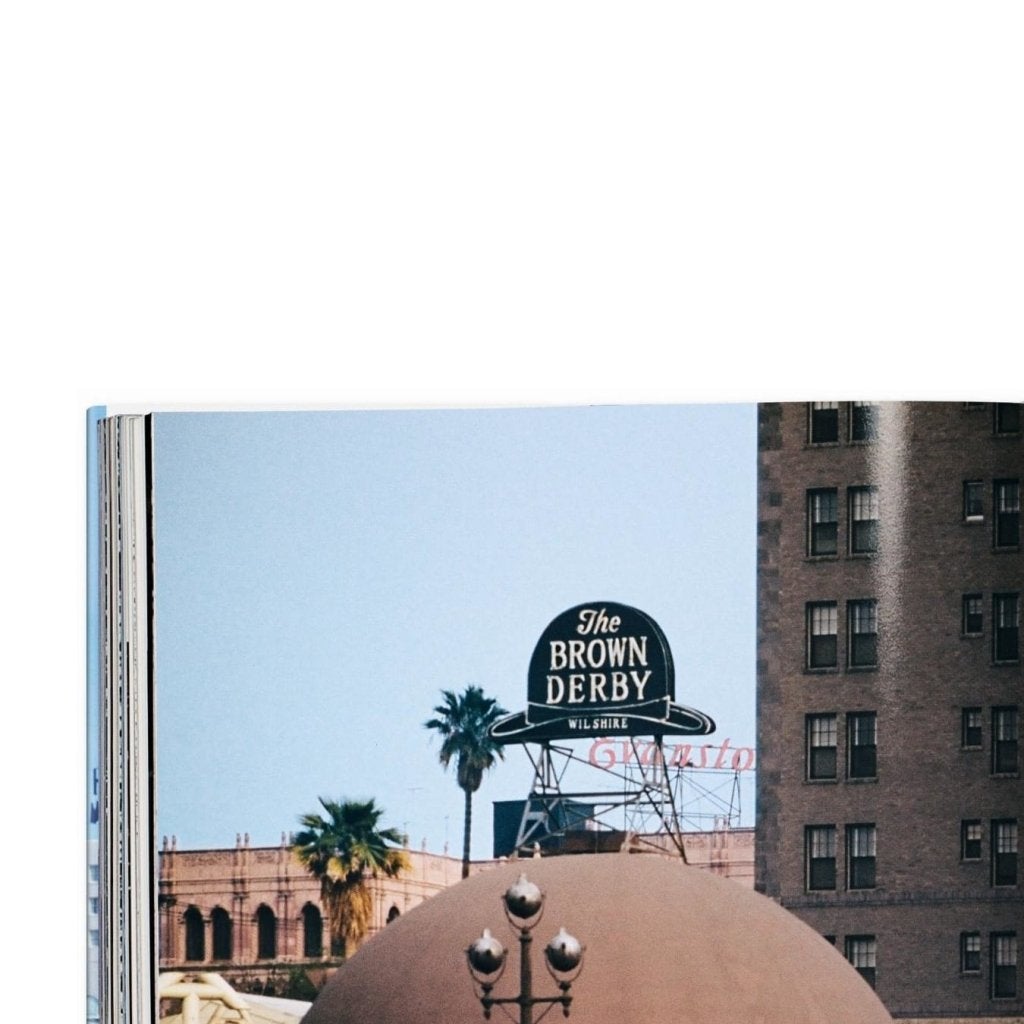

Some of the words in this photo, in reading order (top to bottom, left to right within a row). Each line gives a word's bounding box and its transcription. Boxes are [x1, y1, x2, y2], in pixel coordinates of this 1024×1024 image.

[576, 608, 621, 635] The
[550, 636, 648, 671] BROWN
[546, 671, 653, 705] DERBY
[568, 717, 628, 730] WILSHIRE
